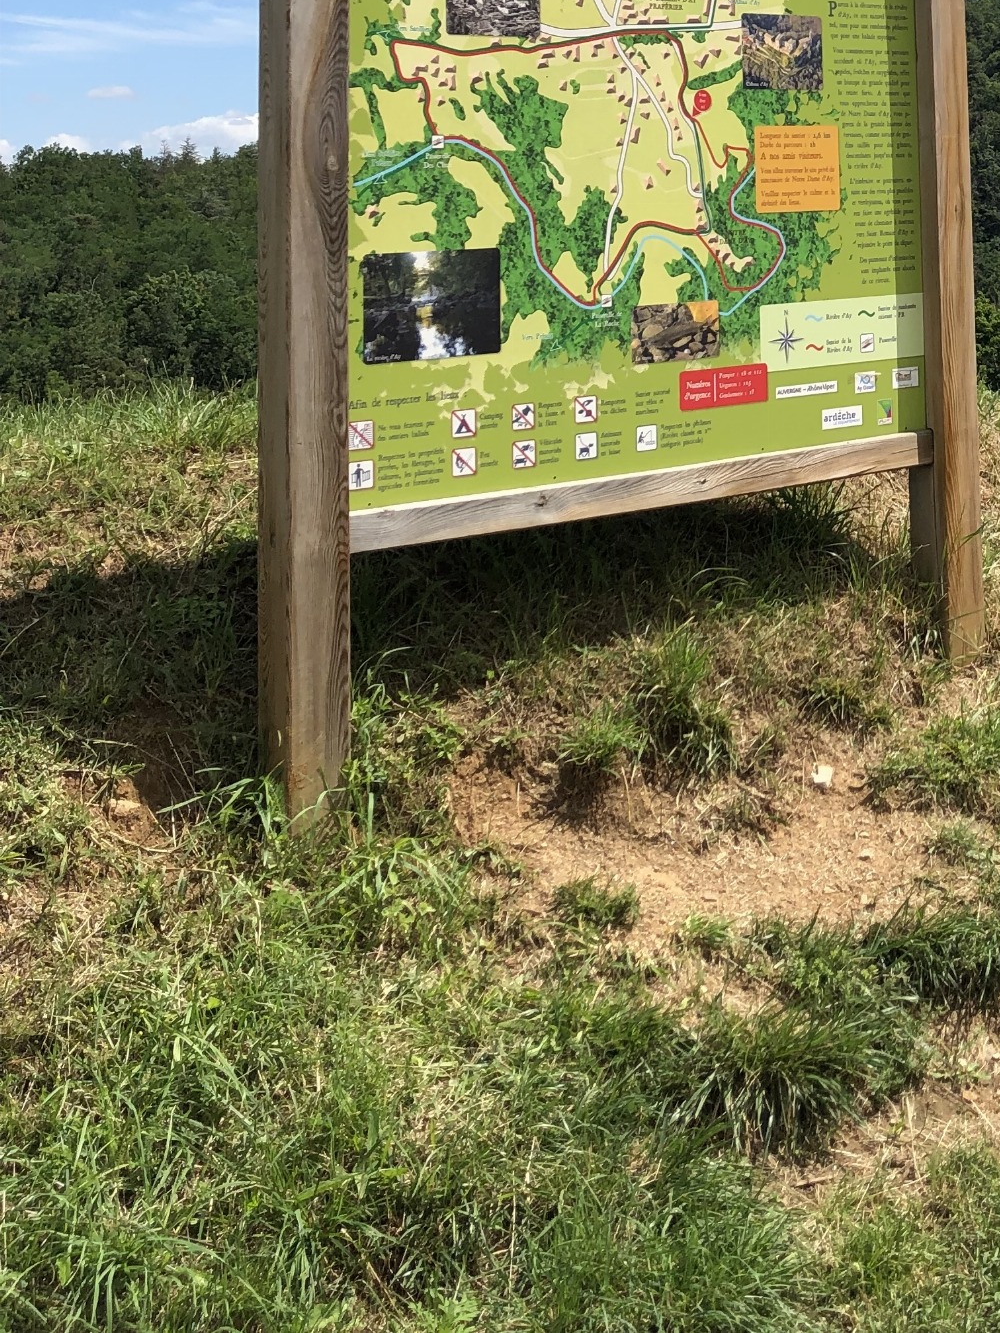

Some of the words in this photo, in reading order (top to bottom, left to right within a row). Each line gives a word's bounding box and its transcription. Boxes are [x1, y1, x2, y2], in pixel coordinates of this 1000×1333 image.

[686, 380, 711, 390] Numéros
[349, 399, 367, 410] Afin
[372, 397, 381, 407] de
[386, 396, 421, 408] respecter
[426, 392, 436, 402] les
